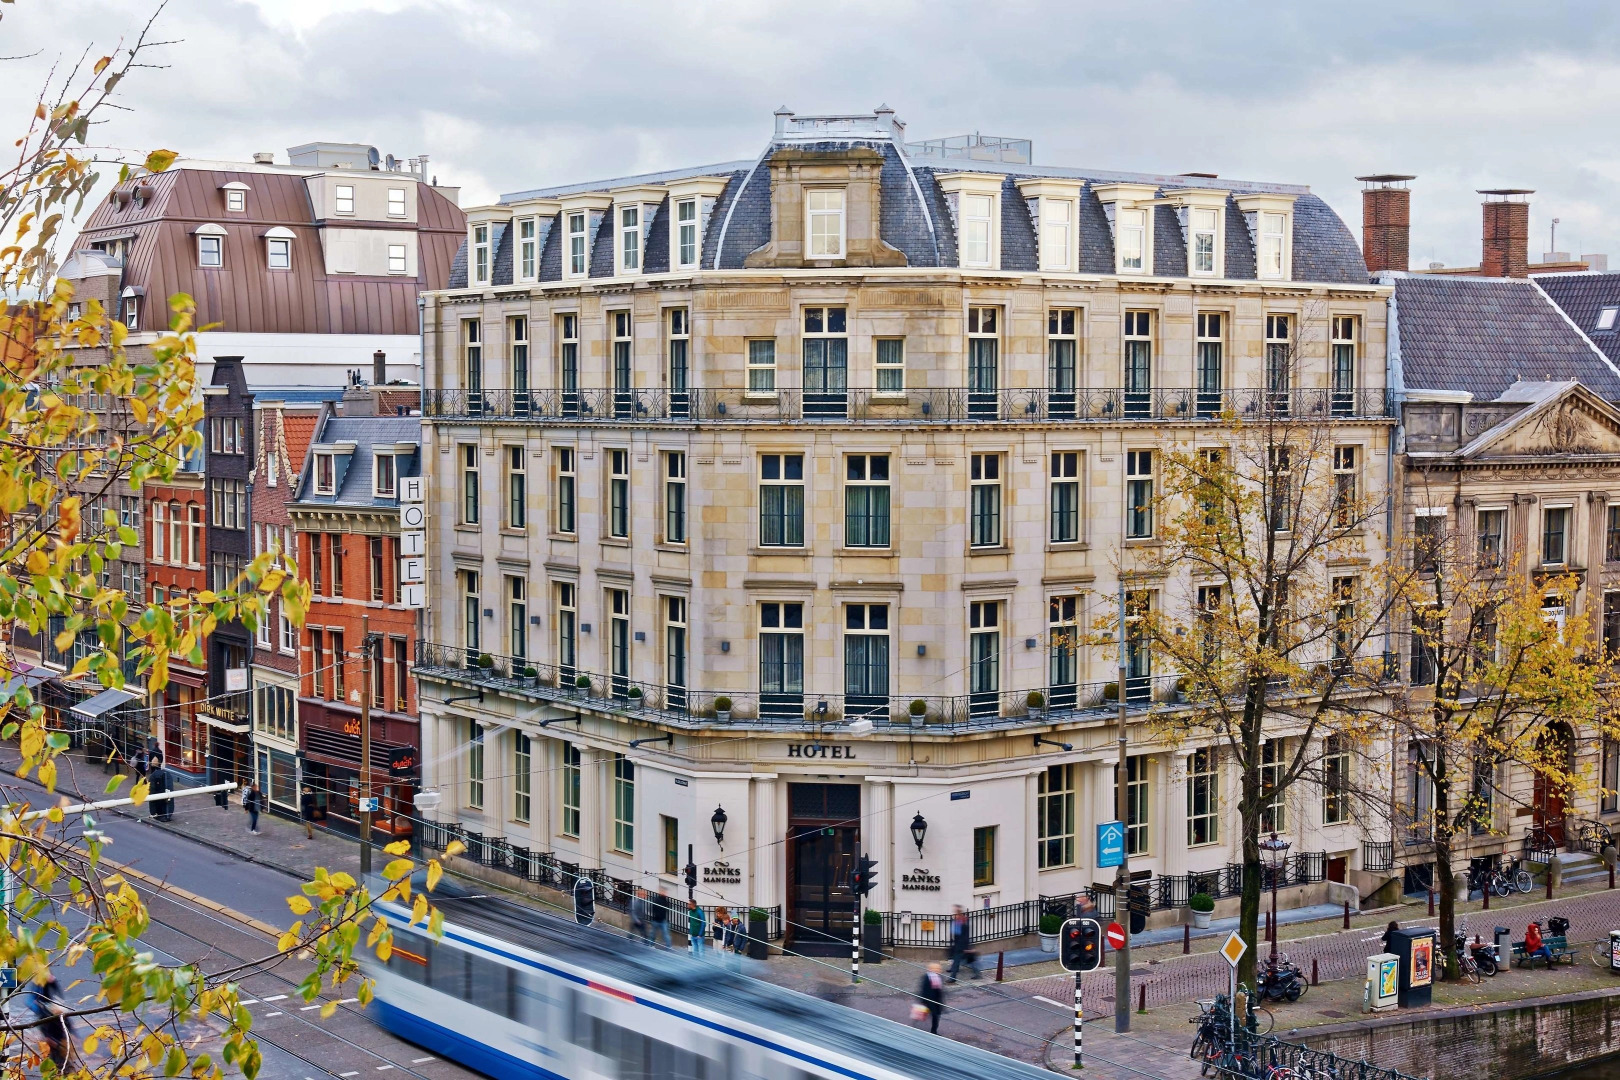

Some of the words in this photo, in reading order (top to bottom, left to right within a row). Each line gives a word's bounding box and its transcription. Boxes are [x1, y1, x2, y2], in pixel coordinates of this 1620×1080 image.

[405, 480, 423, 606] HOTEL
[200, 703, 215, 715] DIRK
[215, 707, 235, 721] WITTE
[344, 720, 361, 735] dutch
[787, 744, 856, 759] HOTEL
[392, 757, 412, 769] dutch
[1107, 833, 1116, 844] P
[703, 867, 741, 876] BANKS
[902, 874, 941, 884] BANKS
[902, 884, 941, 892] MANSION
